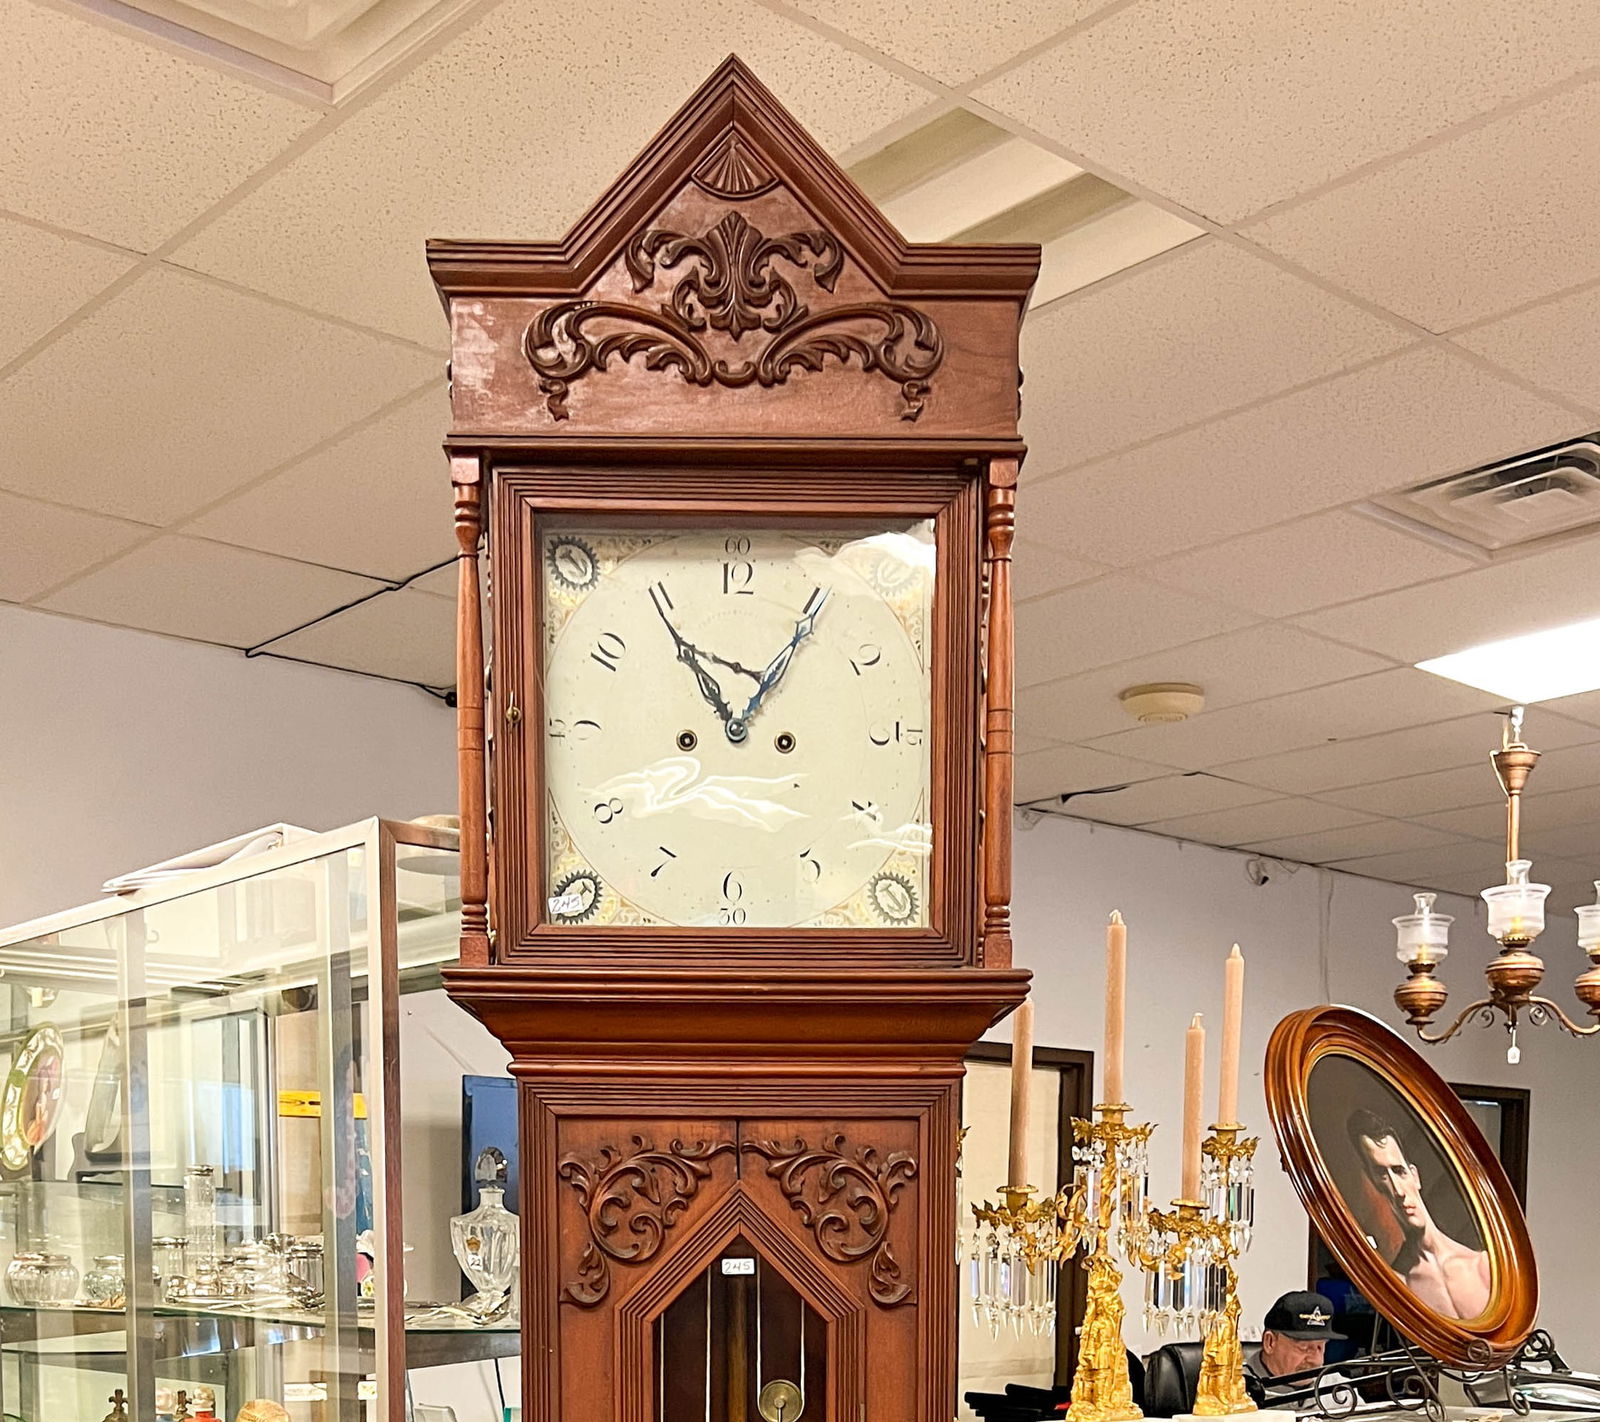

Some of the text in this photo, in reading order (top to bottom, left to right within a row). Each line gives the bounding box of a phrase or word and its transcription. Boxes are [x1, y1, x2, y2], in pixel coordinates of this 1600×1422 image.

[724, 536, 751, 555] 60
[723, 561, 754, 594] 12
[590, 632, 626, 672] 10
[849, 644, 881, 676] 2
[594, 797, 624, 824] 8
[650, 846, 677, 877] 7
[799, 847, 821, 883] 5
[723, 870, 743, 902] 6
[552, 896, 580, 913] 245
[724, 1261, 752, 1275] 245
